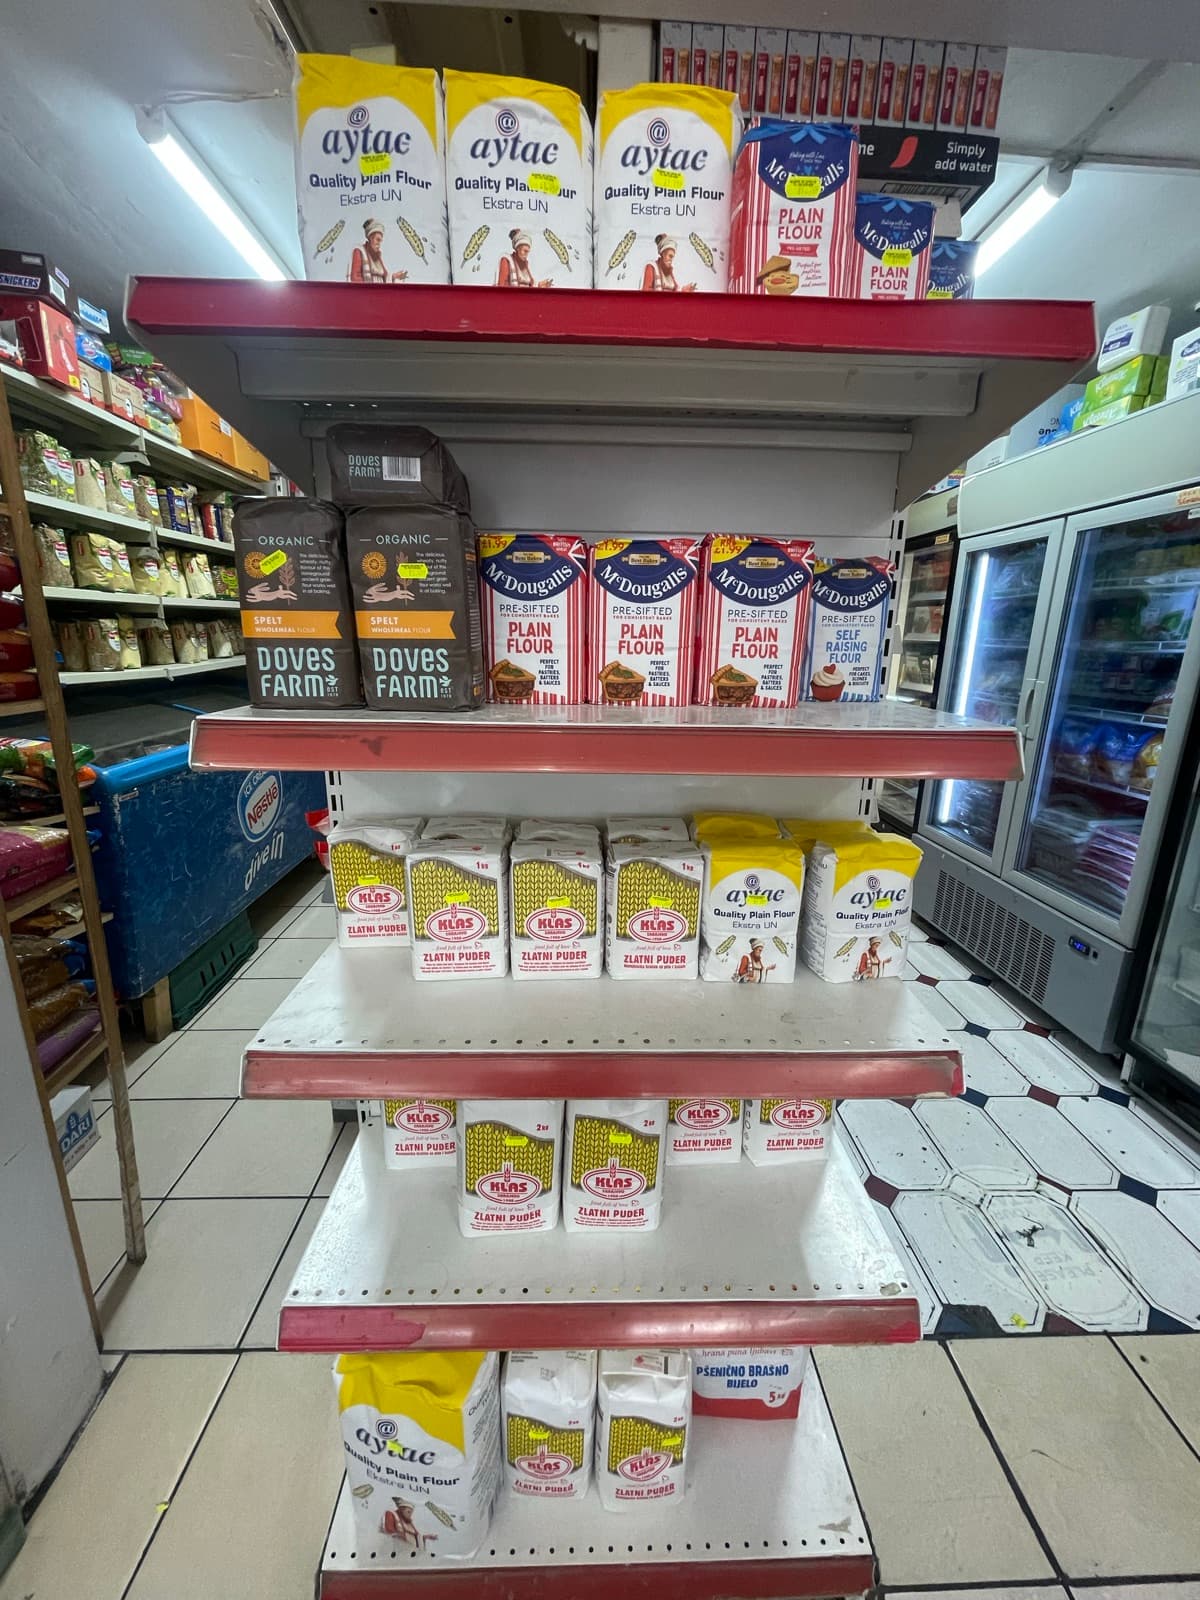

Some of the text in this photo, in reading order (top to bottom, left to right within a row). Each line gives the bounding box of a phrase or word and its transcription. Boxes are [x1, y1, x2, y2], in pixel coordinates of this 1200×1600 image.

[322, 123, 412, 165] aytac
[470, 132, 559, 167] aytac
[946, 141, 985, 159] Simply
[621, 143, 708, 175] aytac
[935, 159, 993, 174] add water
[309, 170, 432, 191] Quality Plain Flour
[455, 177, 501, 196] Quality
[340, 189, 402, 207] Ekstra UN
[604, 186, 725, 201] Quality Plain Flour
[483, 197, 549, 213] Ekstra UN
[631, 203, 696, 217] Ekstra UN
[779, 208, 824, 224] PLAIN
[778, 226, 822, 239] FLOUR
[871, 266, 909, 279] PLAIN
[0, 274, 39, 288] SNICKERS
[870, 279, 908, 291] FLOUR
[349, 466, 376, 478] FARM
[258, 536, 314, 546] ORGANIC
[376, 534, 431, 545] ORGANIC
[486, 562, 573, 596] McDougalls
[600, 564, 687, 599] McDougalls
[716, 568, 804, 602] McDougalls
[812, 579, 887, 608] McDougalls
[500, 604, 559, 613] PRE-SIFTED
[613, 606, 672, 615] PRE-SIFTED
[728, 609, 788, 618] PRE-SIFTED
[254, 616, 282, 625] SPELT
[370, 617, 399, 625] SPELT
[822, 615, 875, 623] PRE-SIFTED
[508, 622, 551, 637] PLAIN
[621, 623, 663, 639] PLAIN
[735, 627, 778, 642] PLAIN
[836, 630, 861, 640] SELF
[507, 638, 553, 654] FLOUR
[618, 640, 664, 655] FLOUR
[732, 643, 778, 659] FLOUR
[826, 641, 868, 652] RAISING
[829, 653, 861, 663] FLOUR
[260, 674, 324, 697] FARM
[376, 675, 438, 698] FARM
[358, 893, 391, 903] KLAS
[714, 909, 747, 920] Quality
[836, 912, 869, 920] Quality
[894, 906, 909, 916] Flour
[348, 924, 407, 934] ZLATNI PUDER
[438, 918, 474, 930] KLAS
[538, 918, 572, 929] KLAS
[640, 920, 675, 931] KLAS
[732, 921, 778, 929] Ekstra UN
[855, 921, 882, 930] Ekstra
[423, 952, 490, 962] ZLATNI PUDER
[521, 951, 587, 961] ZLATNI PUDER
[624, 955, 686, 964] ZLATNI PUDER
[407, 1113, 440, 1123] KLAS
[687, 1109, 720, 1118] KLAS
[782, 1109, 815, 1118] KLAS
[62, 1116, 90, 1152] DARI
[395, 1142, 456, 1152] ZLATNI PUDER
[673, 1138, 732, 1148] ZLATNI PUDER
[767, 1137, 824, 1147] ZLATNI PUDER
[490, 1182, 527, 1193] KLAS
[595, 1177, 632, 1188] KLAS
[474, 1210, 541, 1222] ZLATNI PUDER
[578, 1207, 645, 1217] ZLATNI PUDER
[702, 1349, 725, 1357] hrana
[696, 1364, 789, 1377] PŠENIČNO BRAŠNO
[727, 1379, 758, 1388] BIJELO
[769, 1391, 776, 1403] 5
[344, 1441, 460, 1486] Quality Plain Flour
[528, 1461, 560, 1471] KLAS
[629, 1455, 661, 1472] KLAS
[366, 1470, 430, 1495] Ekstra UN
[515, 1480, 542, 1492] ZLATNI
[545, 1483, 574, 1492] PUDER
[615, 1483, 675, 1496] ZLATNI PUDER
